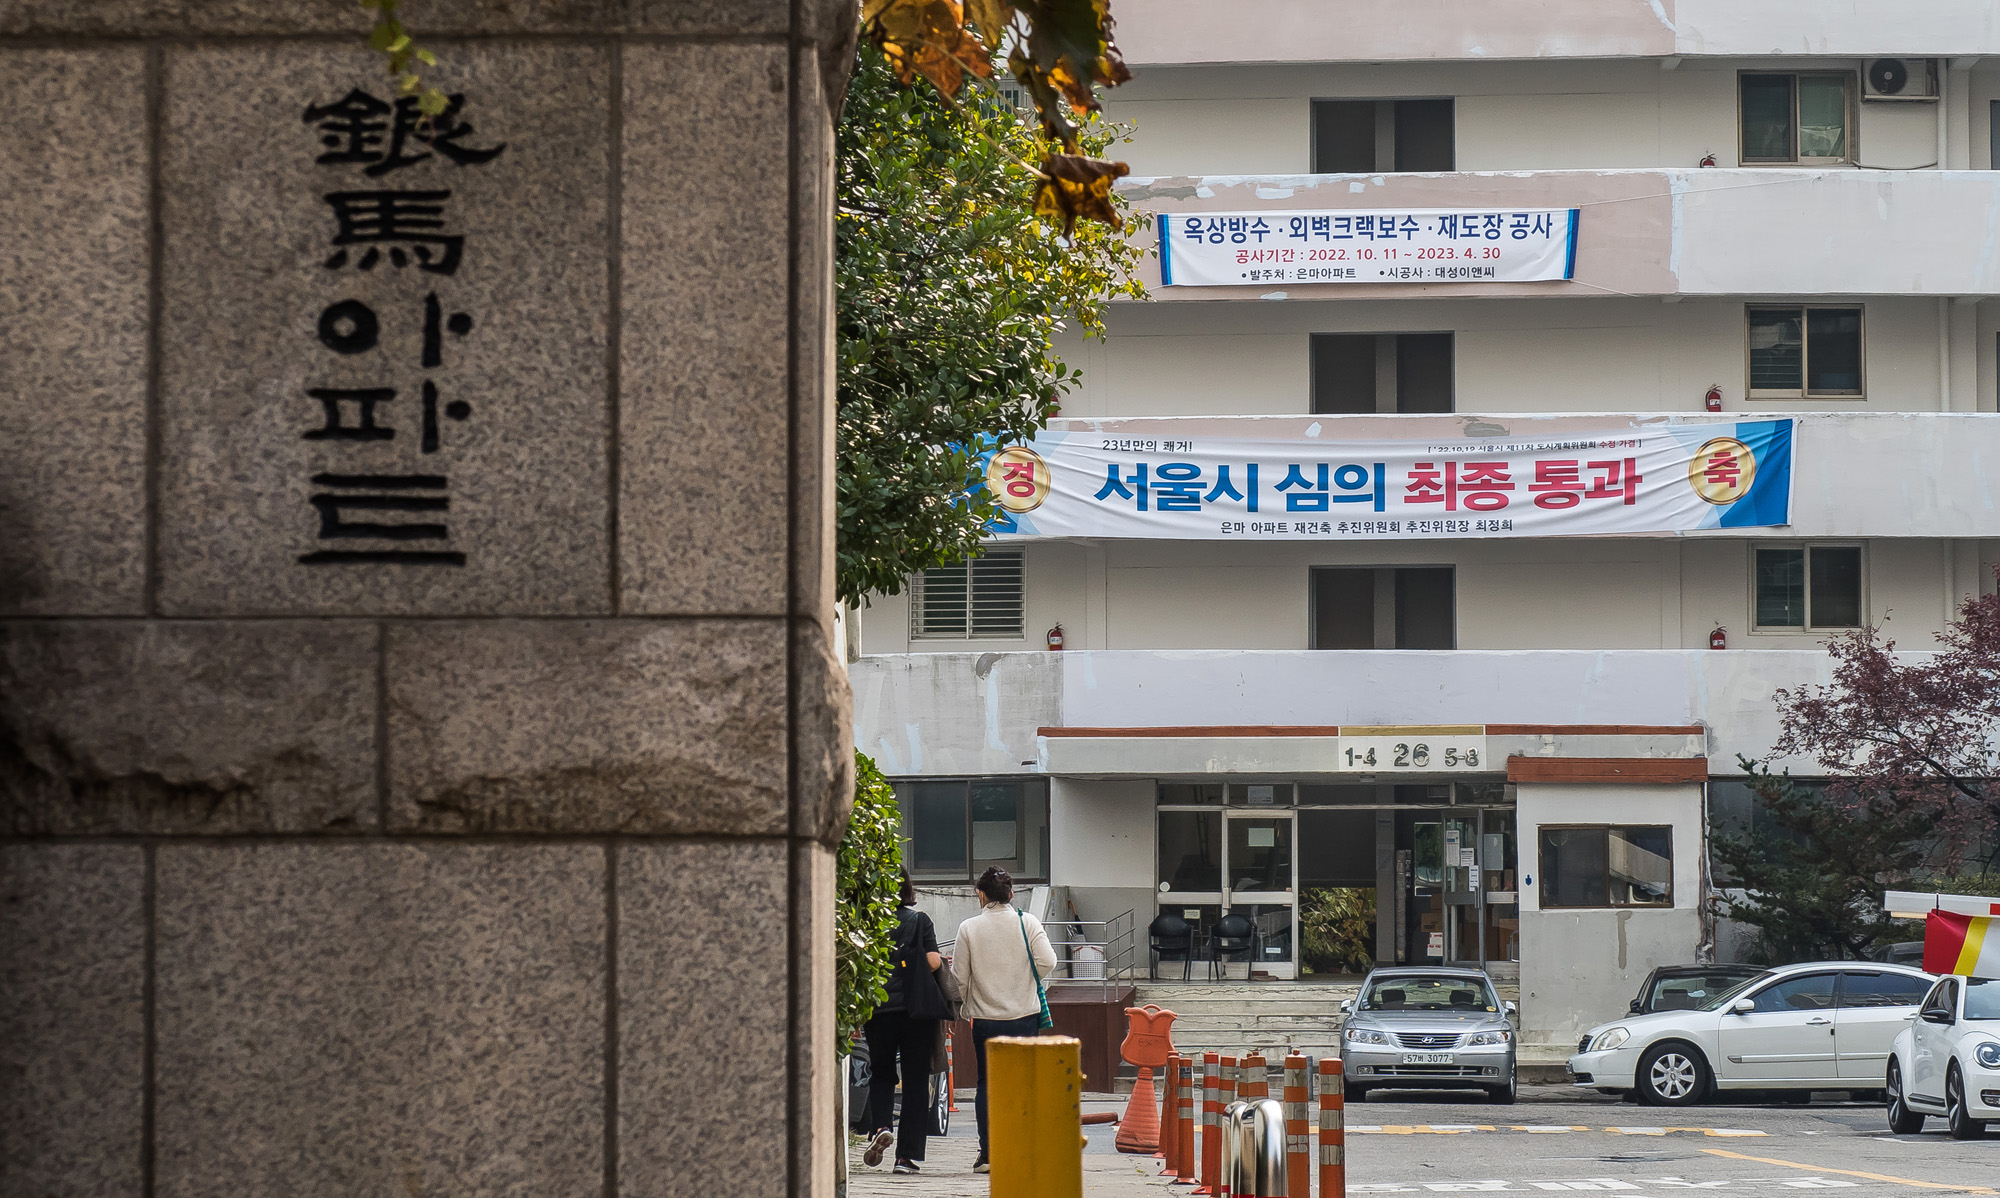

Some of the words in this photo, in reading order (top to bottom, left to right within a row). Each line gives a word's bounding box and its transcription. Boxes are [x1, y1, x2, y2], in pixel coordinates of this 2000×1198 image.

[1183, 216, 1271, 244] 옥상방수
[1288, 215, 1420, 242] 외벽크랙보수
[1437, 213, 1504, 240] 재도장
[1509, 212, 1553, 240] 공사
[1235, 248, 1295, 264] 공사기간
[1308, 248, 1350, 261] 2022.
[1356, 248, 1377, 260] 10.
[1383, 248, 1398, 260] 11
[1417, 247, 1459, 260] 2023.
[1464, 247, 1477, 260] 4.
[1482, 247, 1501, 260] 30
[1250, 268, 1285, 281] 발주처
[1296, 267, 1357, 280] 은마아파트
[1387, 266, 1424, 280] 시공사
[1435, 266, 1496, 279] 대성이앤씨
[1102, 439, 1157, 453] 23년만의
[1163, 441, 1193, 453] 쾌거!
[1599, 440, 1616, 449] 수정
[1619, 439, 1636, 448] 가결
[1703, 451, 1741, 488] 축
[1003, 461, 1035, 498] 경
[1094, 462, 1259, 512] 서울시
[1274, 462, 1385, 512] 심의
[1403, 461, 1515, 511] 최종
[1528, 457, 1643, 509] 통과
[1221, 521, 1245, 534] 은마
[1251, 521, 1289, 534] 아파트
[1294, 521, 1332, 534] 재건축
[1337, 521, 1401, 534] 추진위원회
[1406, 520, 1469, 534] 추진위원장
[1393, 743, 1430, 767] 26
[1427, 1054, 1449, 1063] 3077
